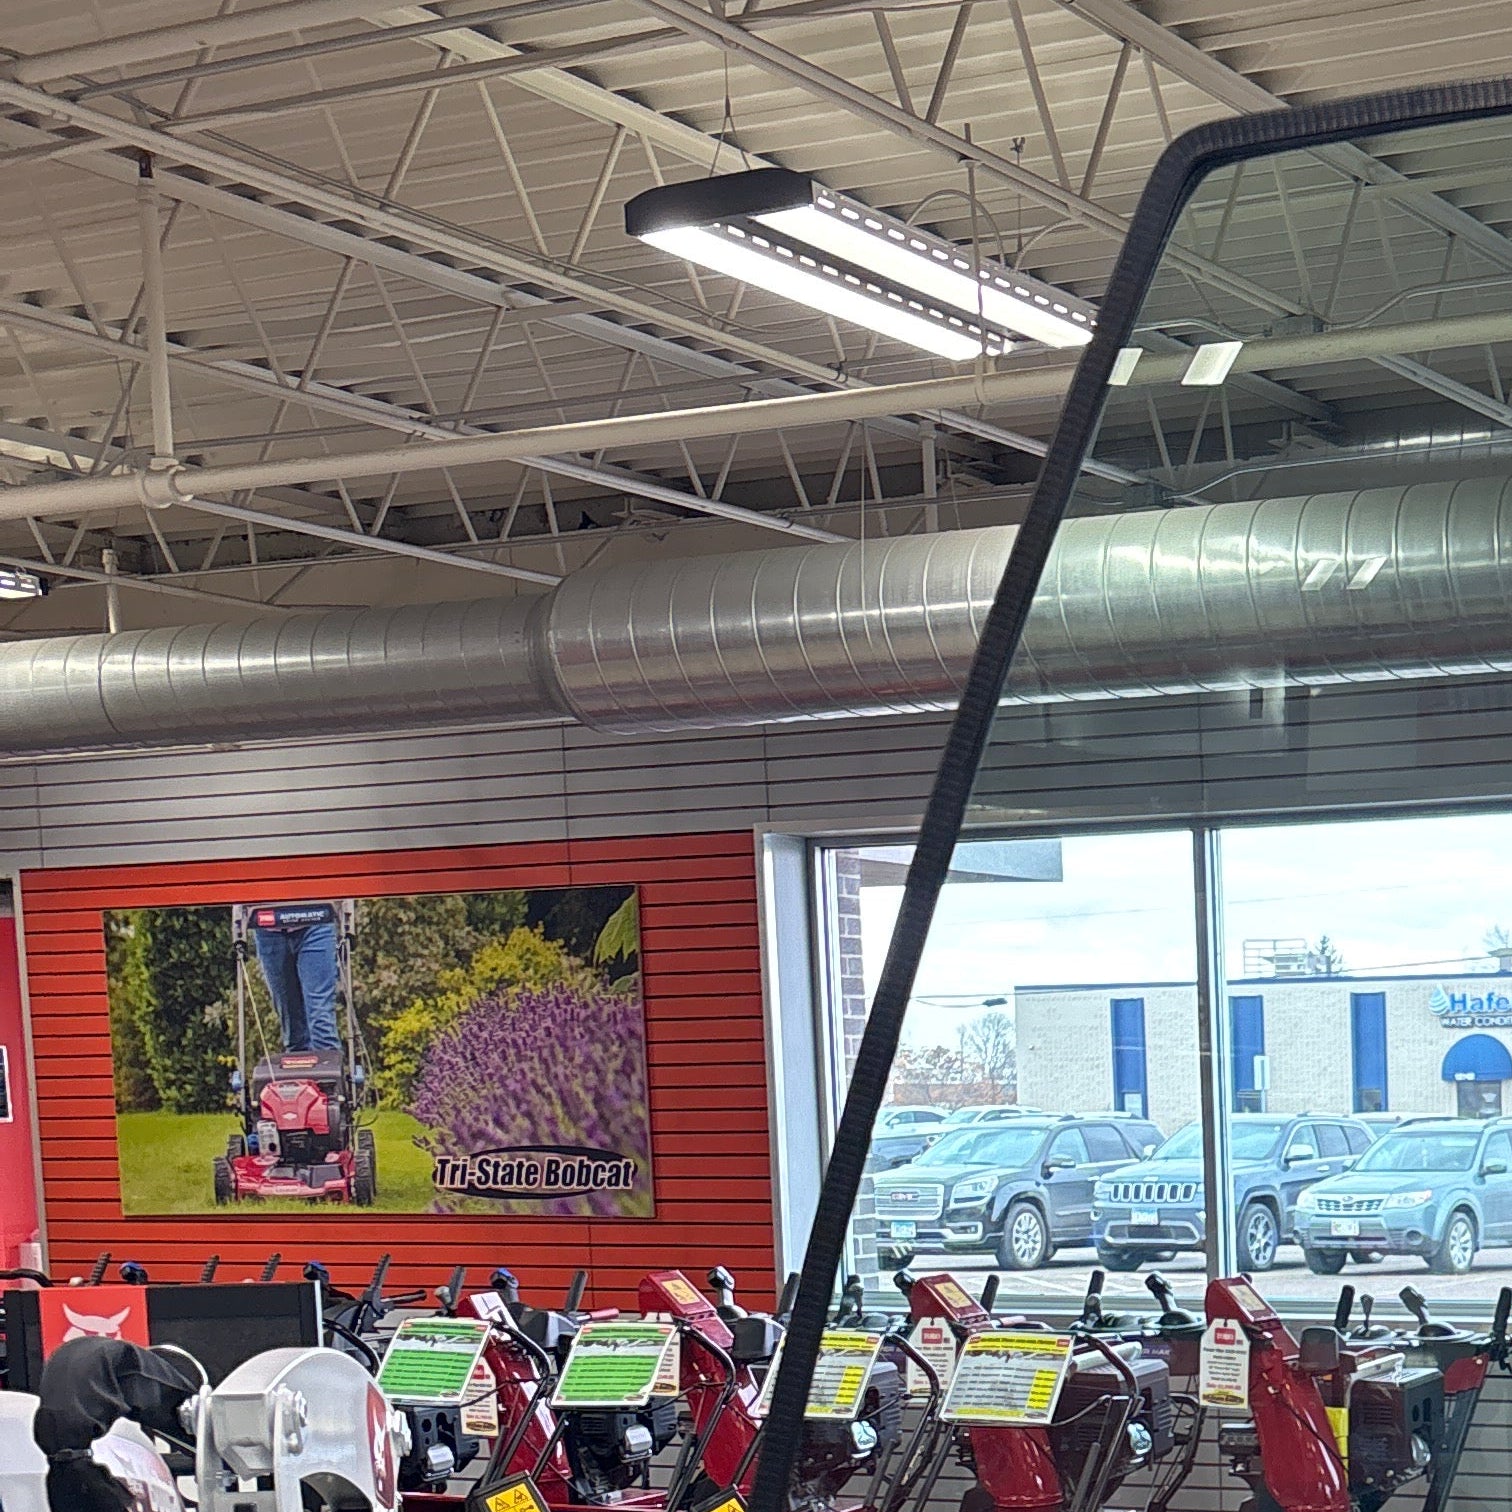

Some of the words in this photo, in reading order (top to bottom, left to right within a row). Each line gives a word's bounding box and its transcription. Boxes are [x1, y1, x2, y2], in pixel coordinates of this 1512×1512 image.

[1441, 1016, 1473, 1028] WATER
[436, 1156, 540, 1189] Tri-State
[544, 1156, 634, 1190] Bobcat
